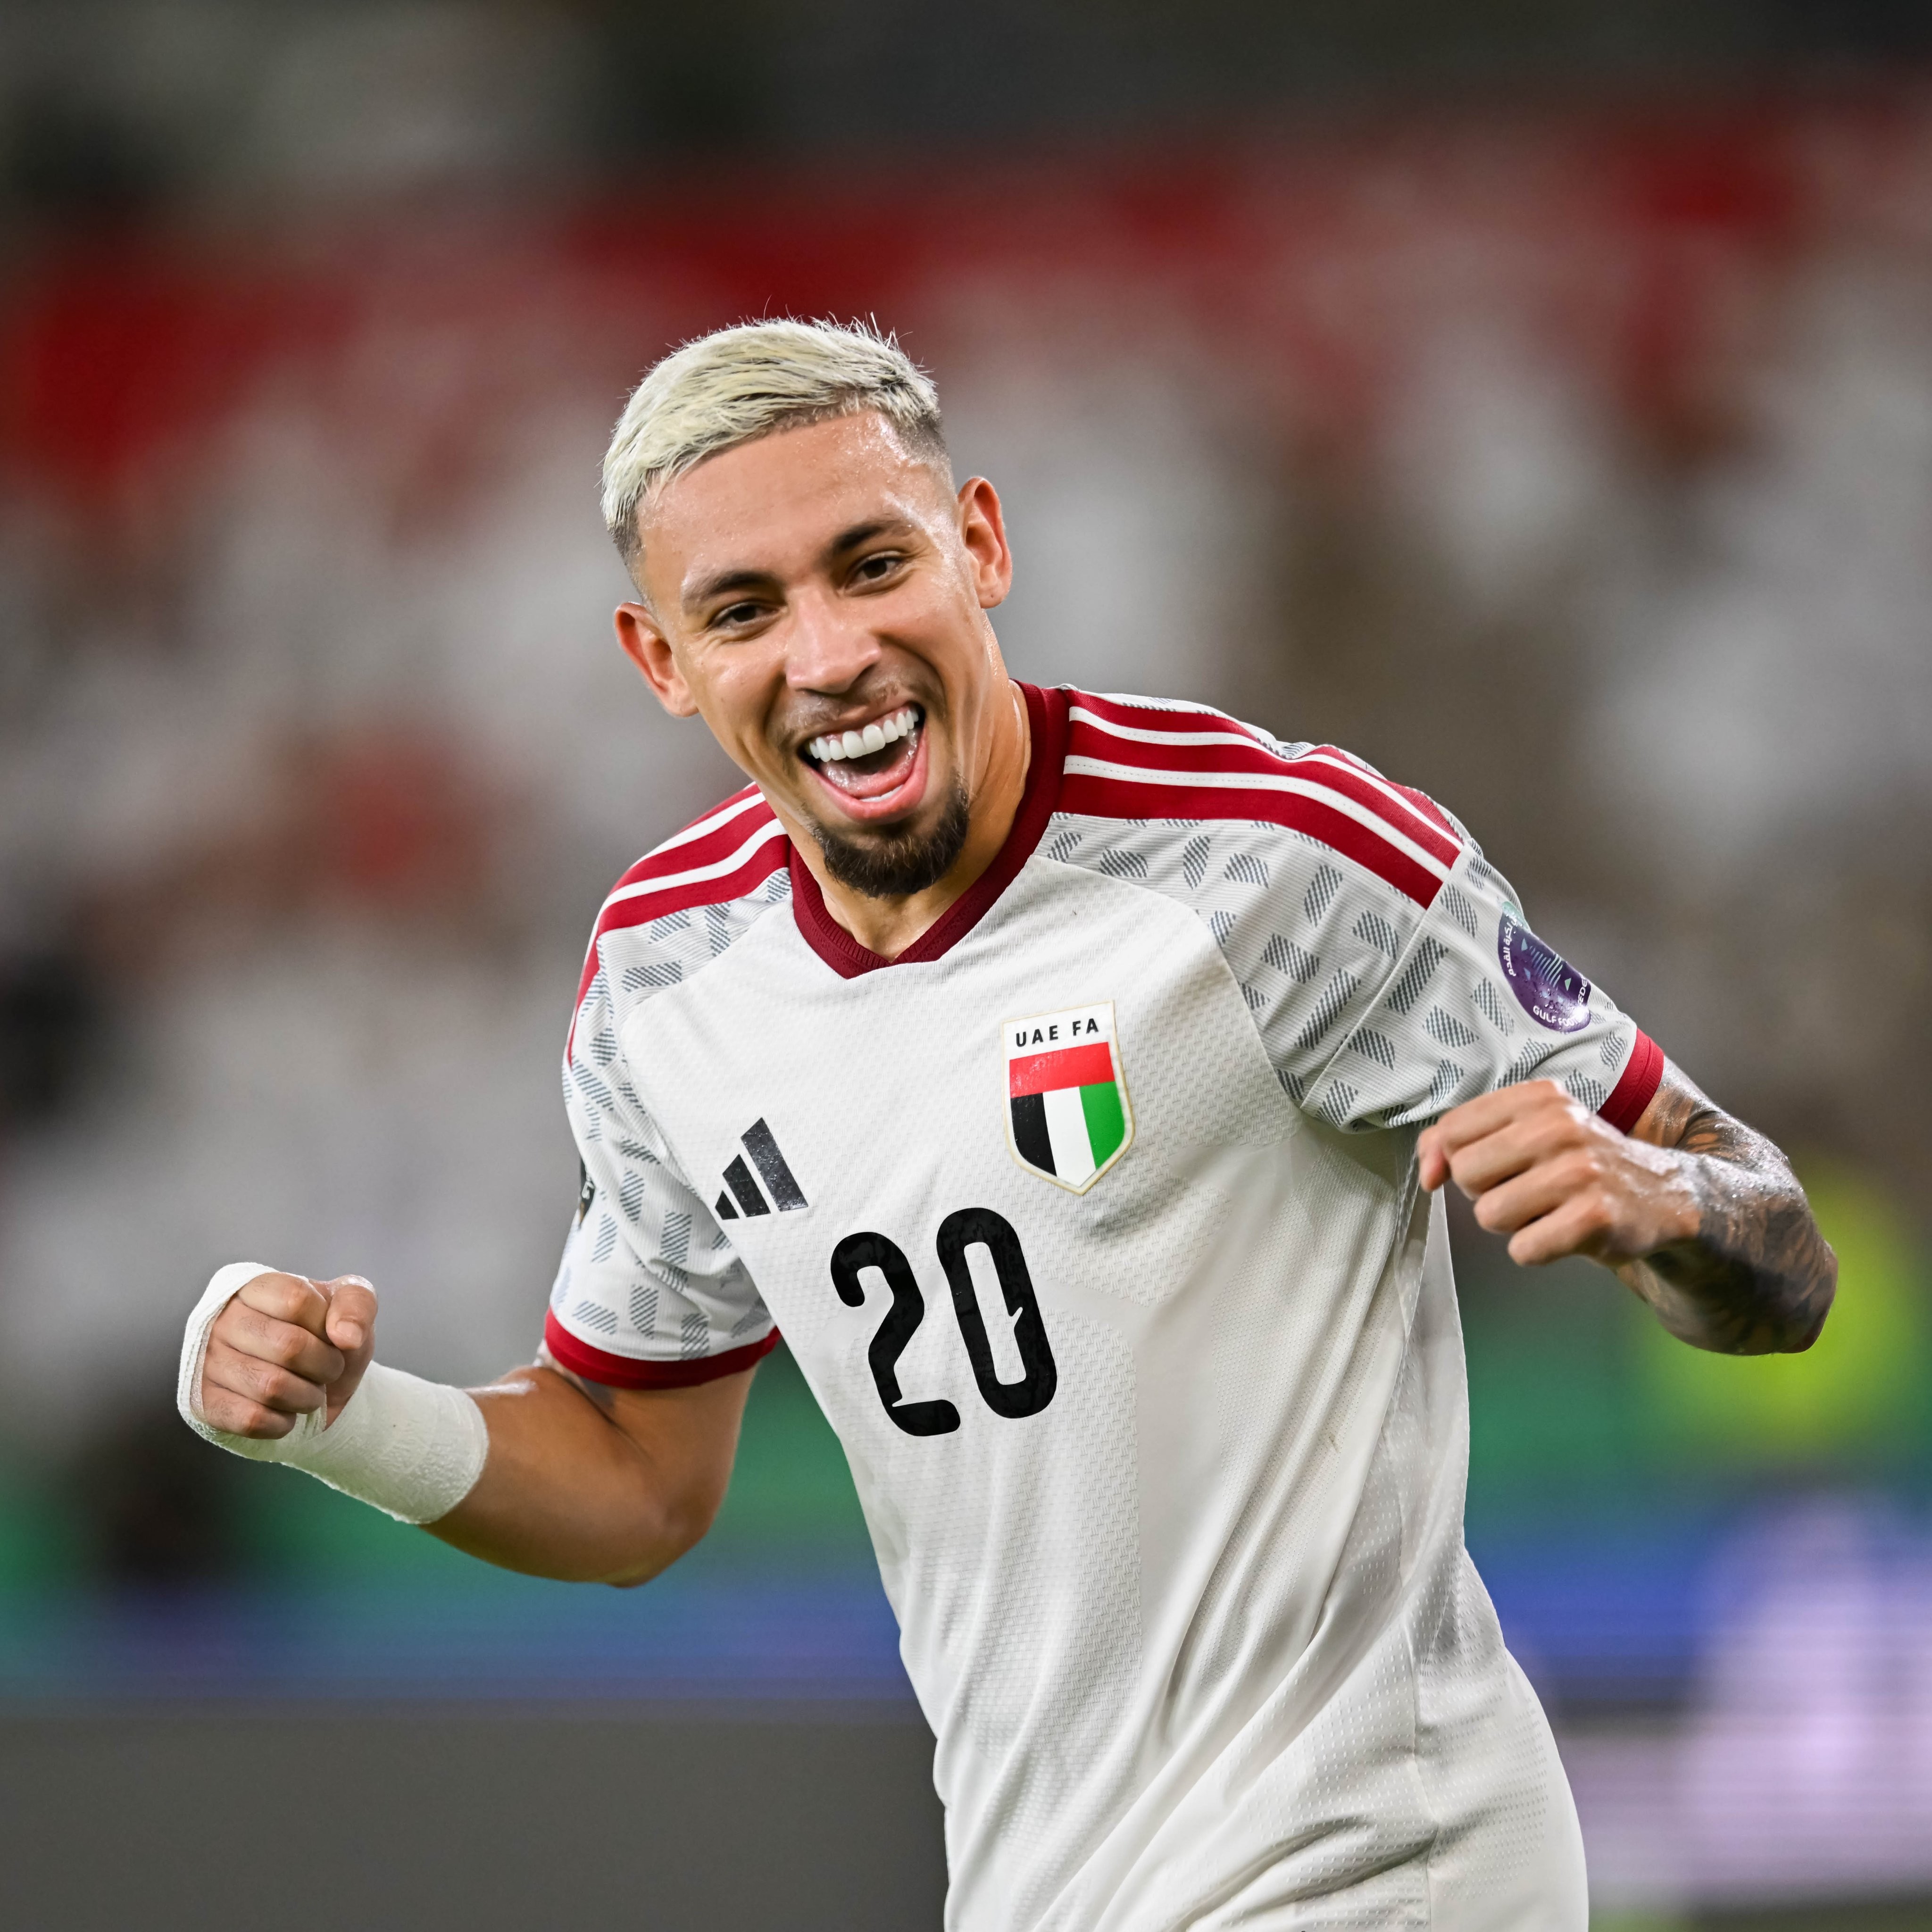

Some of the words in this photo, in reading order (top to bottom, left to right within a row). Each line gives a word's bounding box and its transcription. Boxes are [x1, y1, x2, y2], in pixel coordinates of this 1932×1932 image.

[1503, 947, 1516, 976] القدم
[1533, 1005, 1557, 1024] GULF
[1016, 1025, 1058, 1047] UAE
[1073, 1018, 1099, 1036] FA
[831, 1208, 1058, 1436] 20
